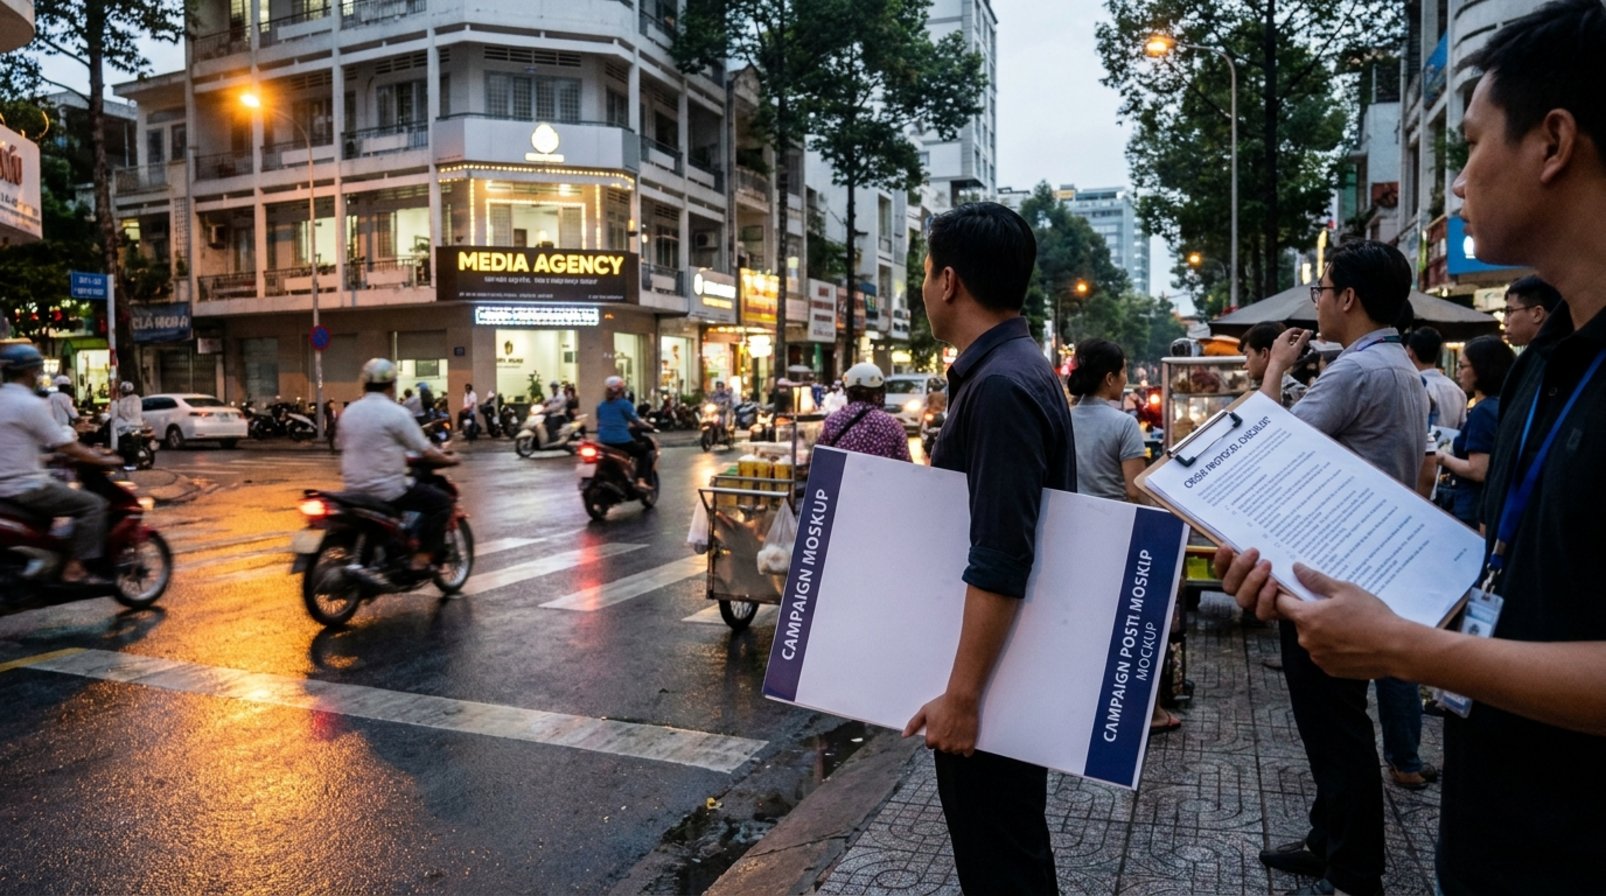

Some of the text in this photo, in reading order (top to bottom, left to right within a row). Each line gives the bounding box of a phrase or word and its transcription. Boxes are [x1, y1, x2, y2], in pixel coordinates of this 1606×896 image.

[458, 251, 624, 275] MEDIA AGENCY
[782, 488, 829, 660] CAMPAIGN MOSKUP
[1136, 621, 1157, 681] MOCKUP
[1103, 660, 1131, 743] CAMPAIGN
